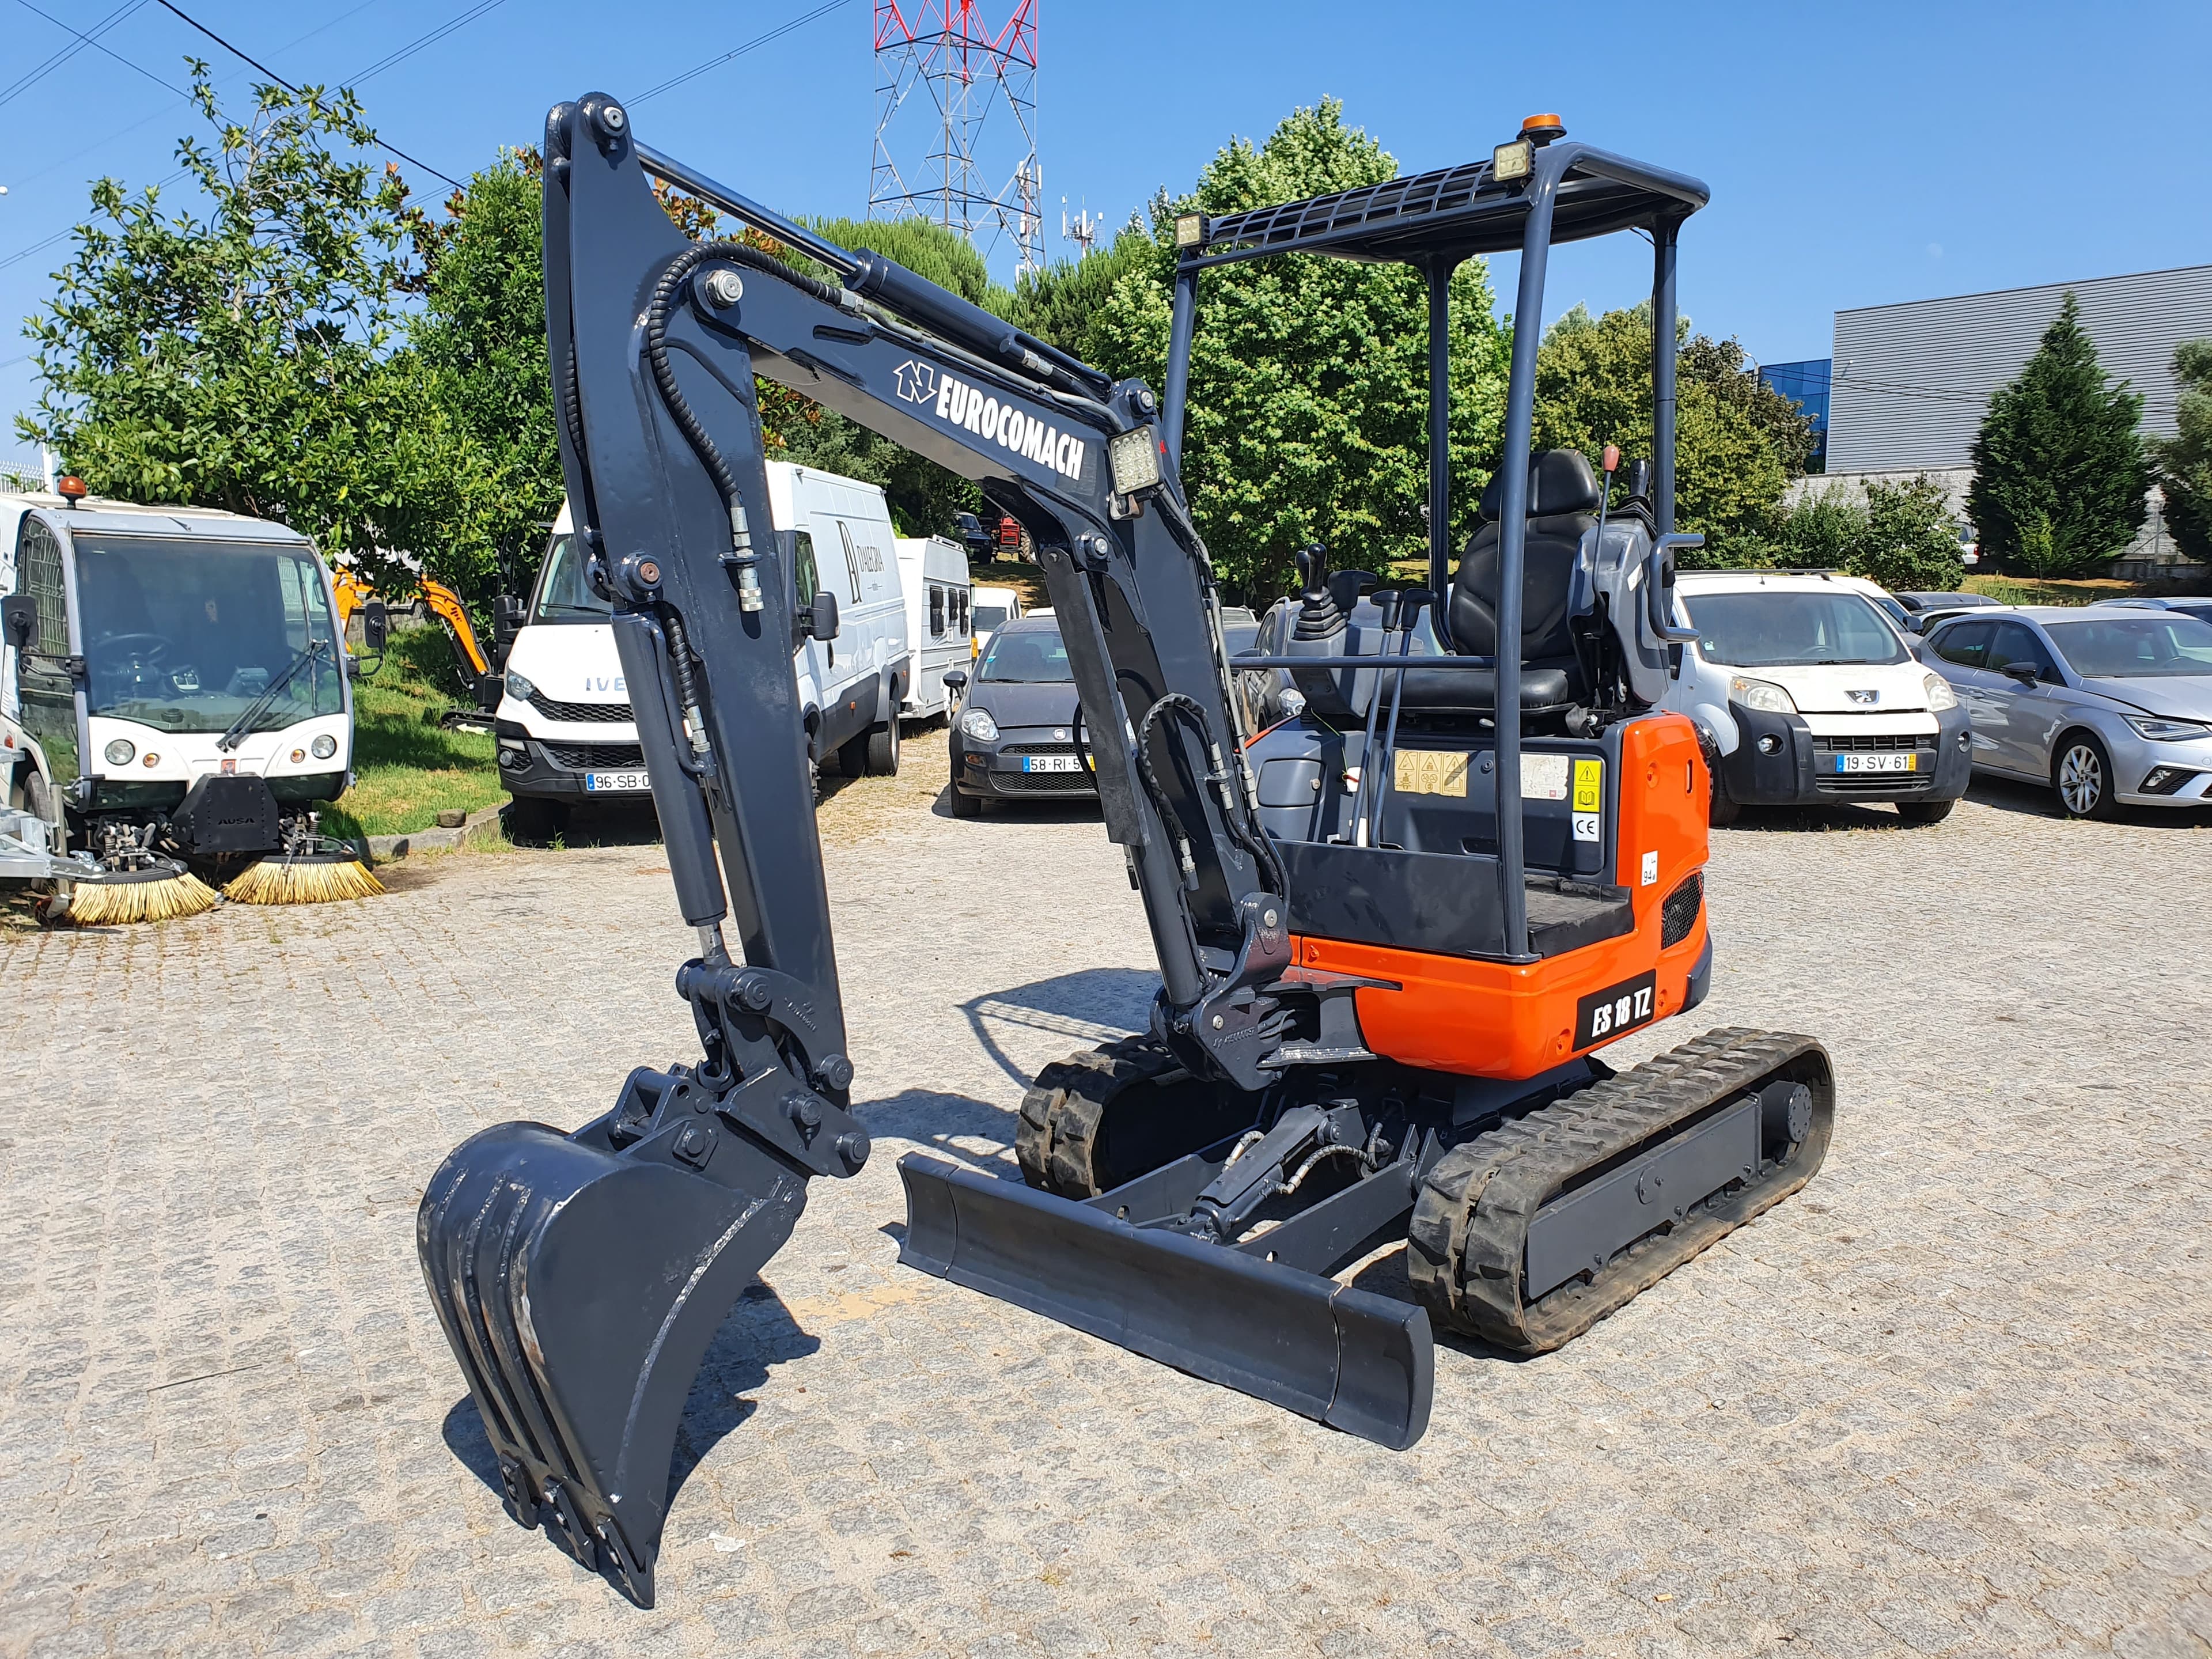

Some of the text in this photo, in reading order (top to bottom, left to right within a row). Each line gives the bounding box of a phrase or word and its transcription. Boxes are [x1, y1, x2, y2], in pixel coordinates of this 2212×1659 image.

[936, 374, 1084, 481] EUROCOMACH
[218, 817, 255, 825] AUSA
[1577, 820, 1595, 835] CE
[1592, 986, 1652, 1037] ES 18 TZ
